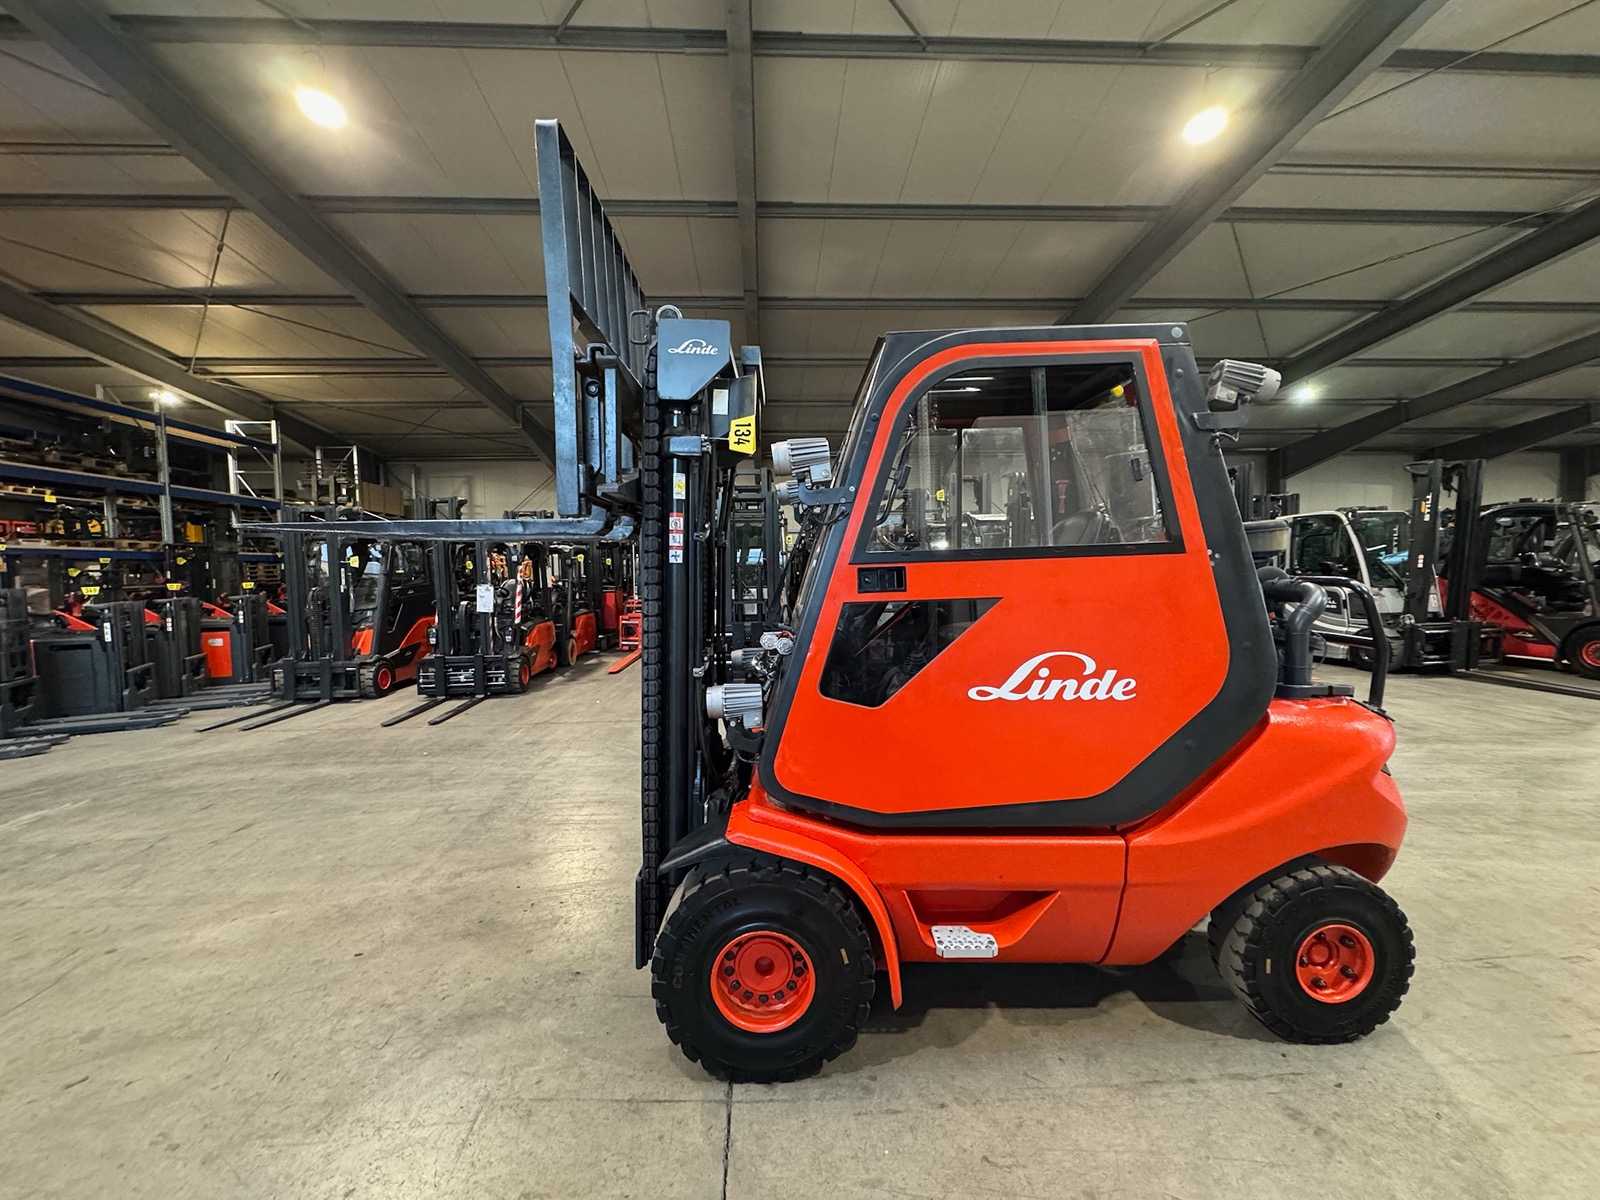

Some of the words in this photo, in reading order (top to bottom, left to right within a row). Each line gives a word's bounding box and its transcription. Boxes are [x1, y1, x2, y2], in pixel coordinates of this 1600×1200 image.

[667, 338, 719, 355] Linde
[733, 423, 751, 446] 134
[967, 651, 1137, 701] Linde
